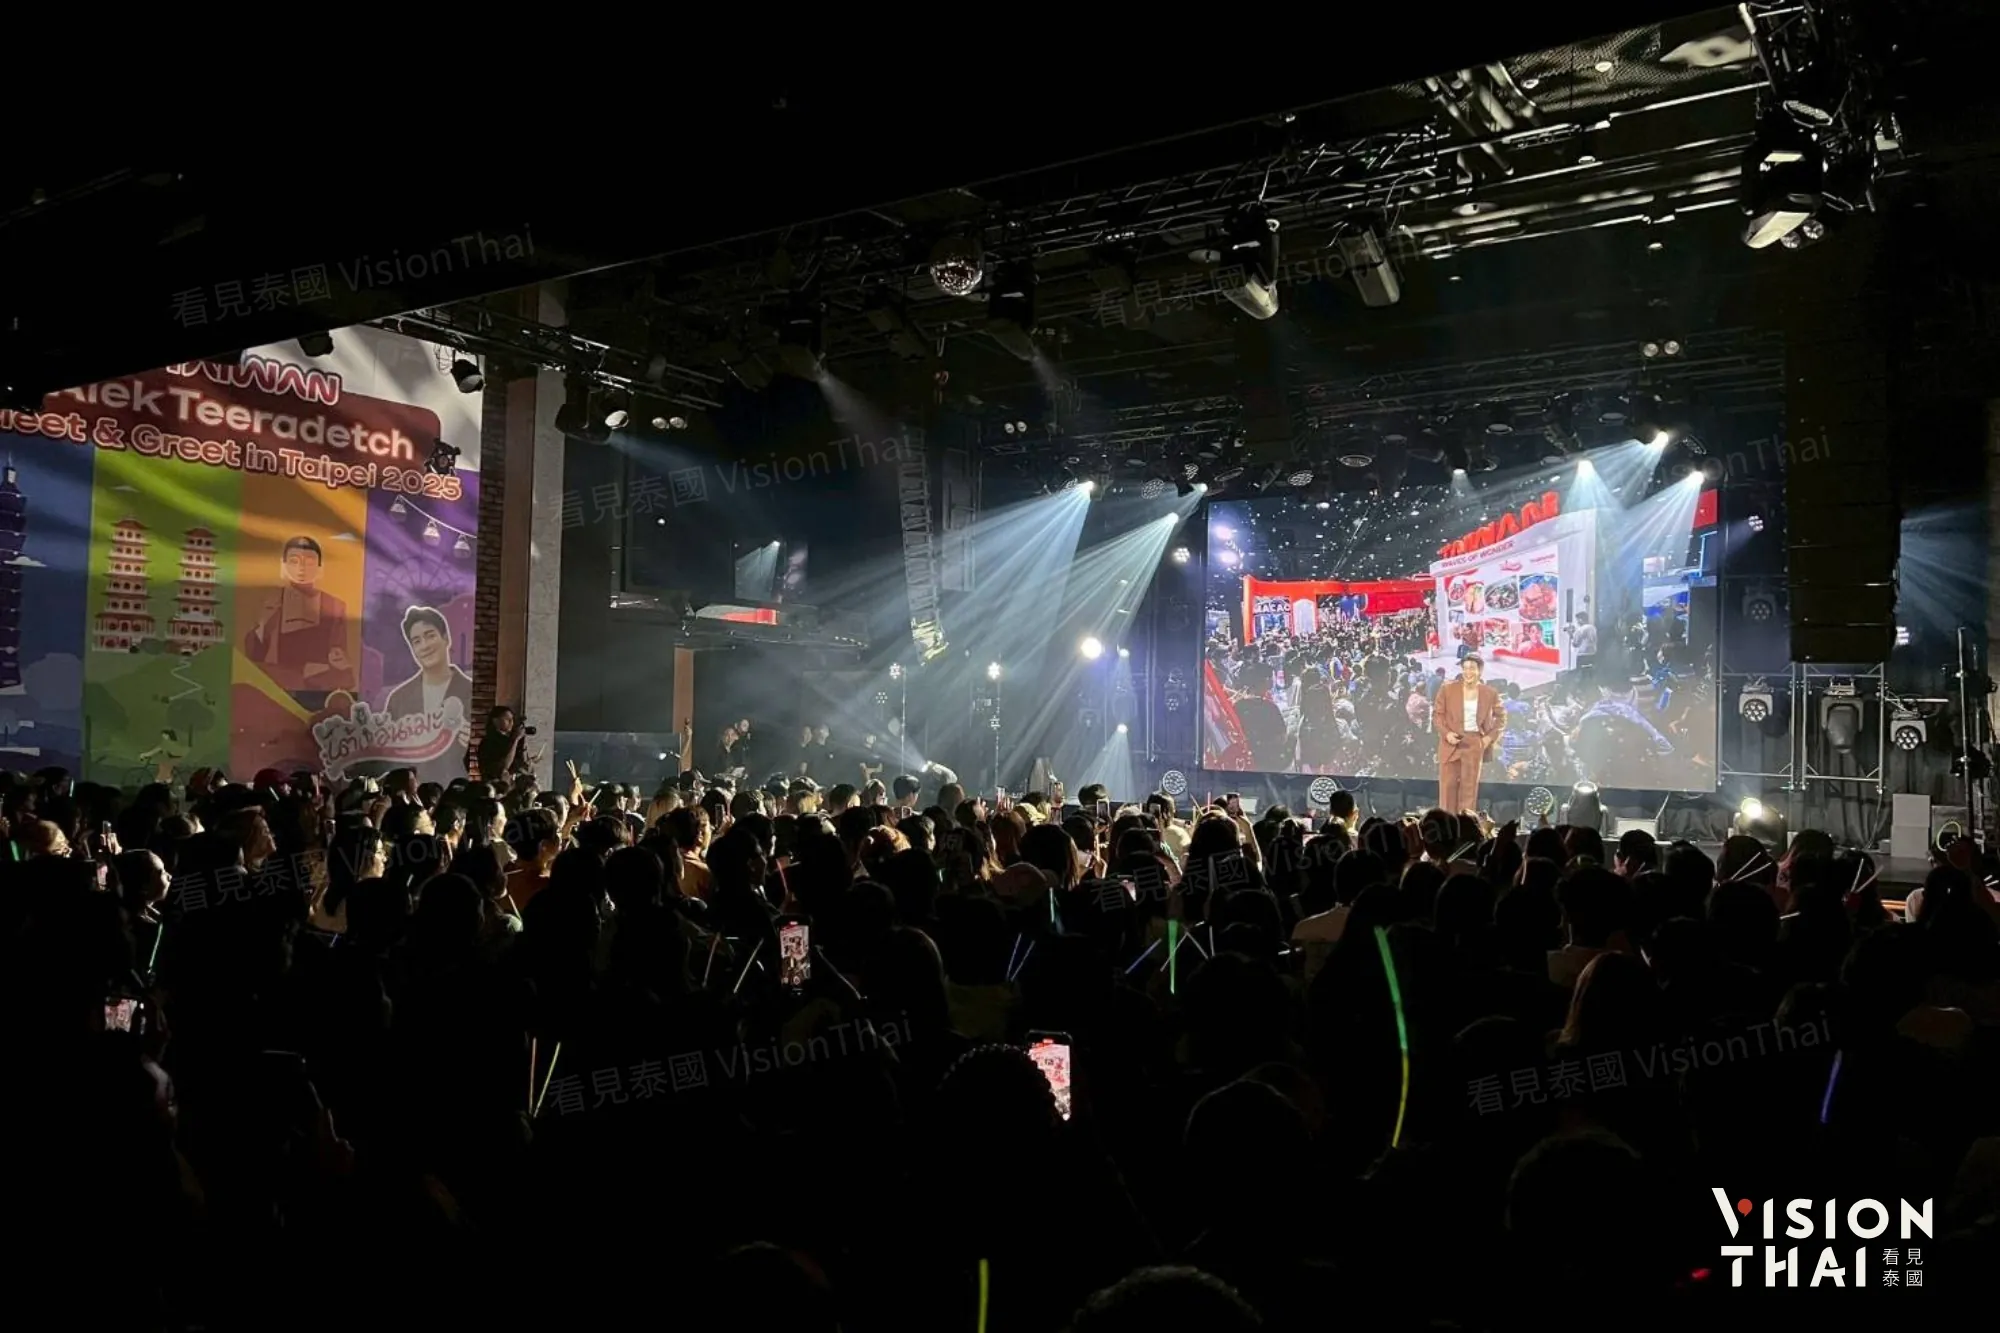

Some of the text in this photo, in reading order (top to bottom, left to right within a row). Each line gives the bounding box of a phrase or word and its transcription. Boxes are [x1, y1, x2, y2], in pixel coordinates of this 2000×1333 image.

[92, 416, 127, 450] &
[130, 423, 240, 469] Greet
[245, 441, 278, 473] in
[278, 448, 378, 489] Taipei
[381, 465, 463, 501] 2025
[168, 385, 414, 461] Teeradetch
